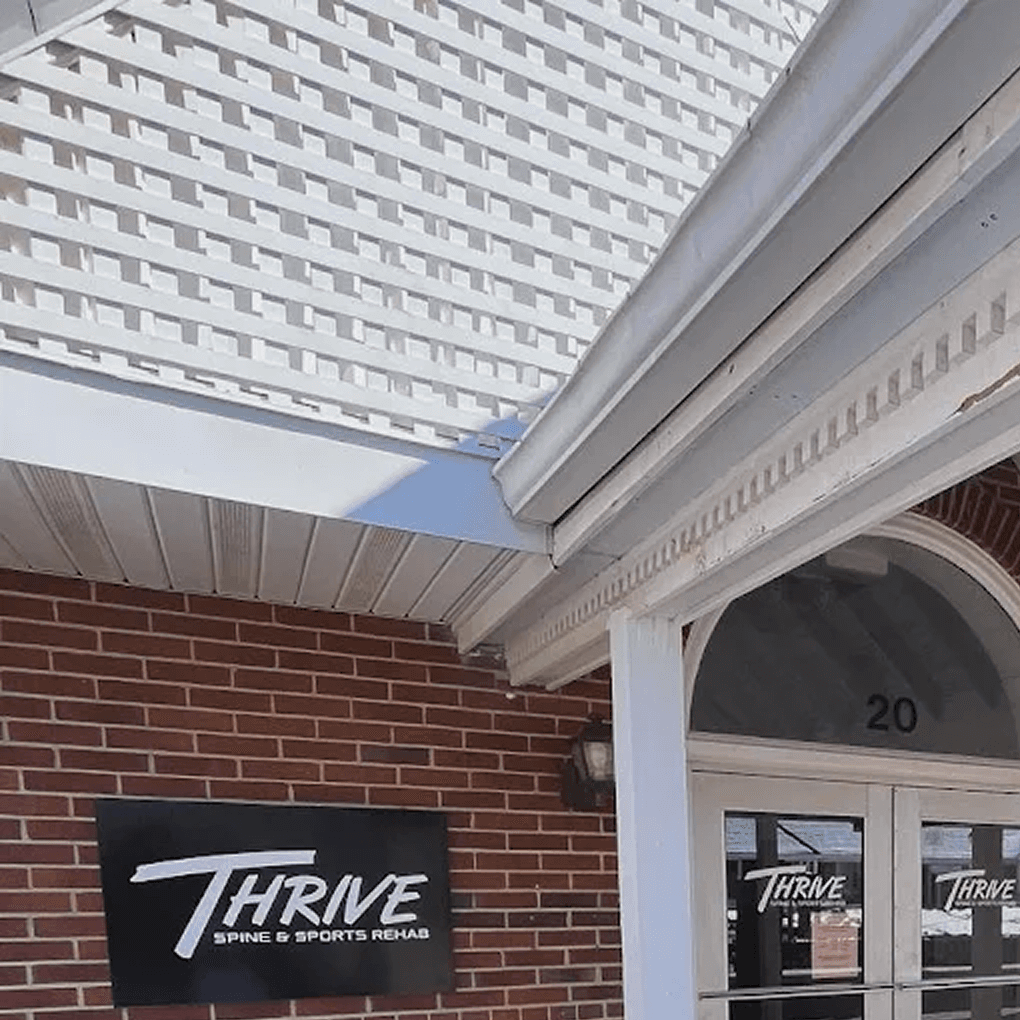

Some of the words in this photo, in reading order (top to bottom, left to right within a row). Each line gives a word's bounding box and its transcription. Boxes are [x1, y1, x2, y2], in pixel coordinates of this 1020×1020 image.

[866, 694, 918, 733] 20
[130, 850, 429, 960] THRIVE
[744, 865, 847, 913] THRIVE
[935, 869, 1017, 912] THRIVE
[213, 931, 272, 945] SPINE
[276, 931, 290, 944] &
[294, 929, 367, 943] SPORTS
[371, 927, 430, 941] REHAB
